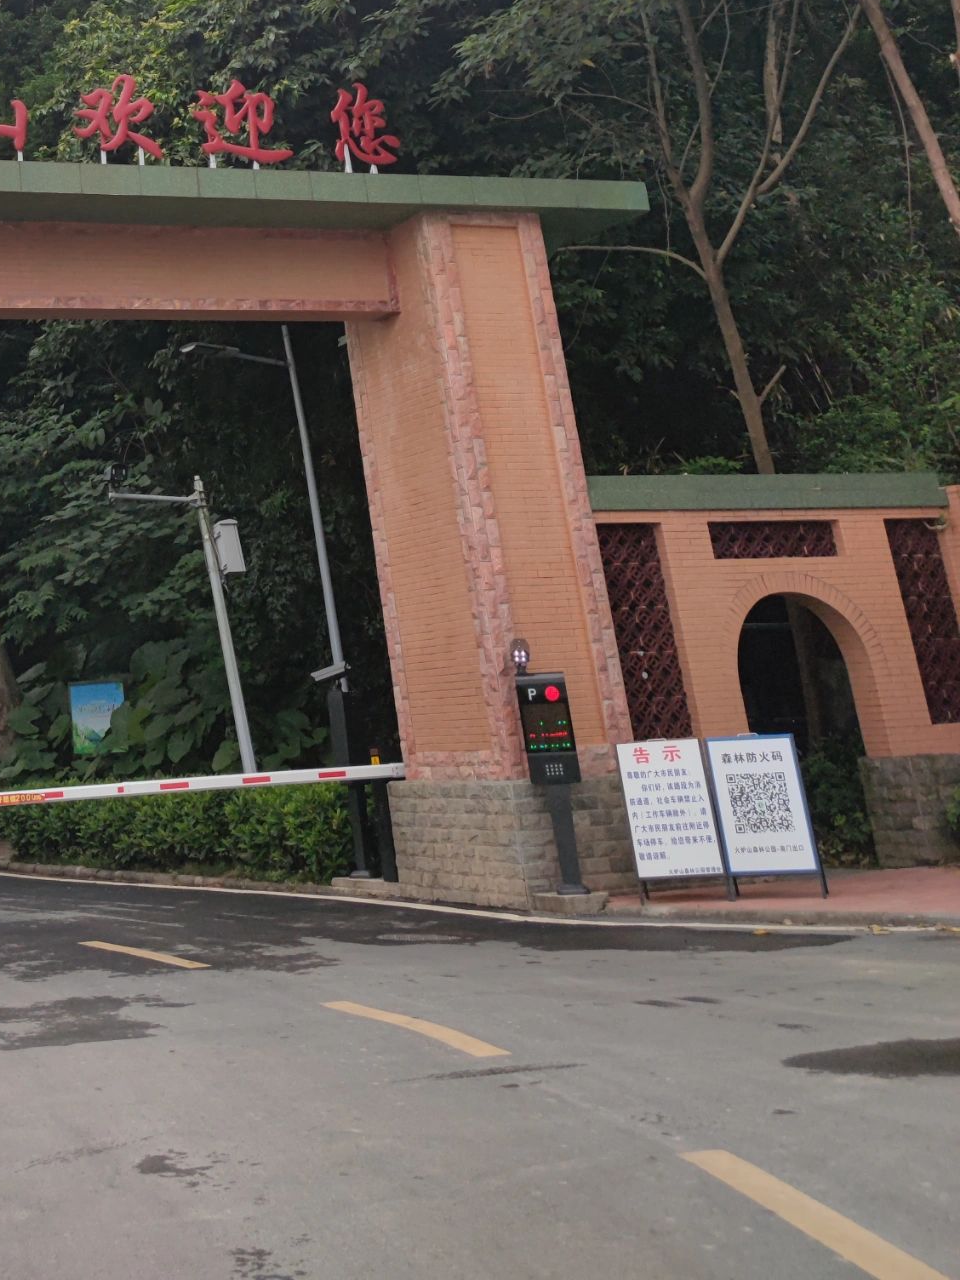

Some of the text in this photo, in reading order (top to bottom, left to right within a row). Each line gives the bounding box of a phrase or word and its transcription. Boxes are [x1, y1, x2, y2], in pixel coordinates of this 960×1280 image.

[527, 688, 537, 701] P
[632, 745, 681, 764] 告示
[721, 751, 783, 765] 森林防火码
